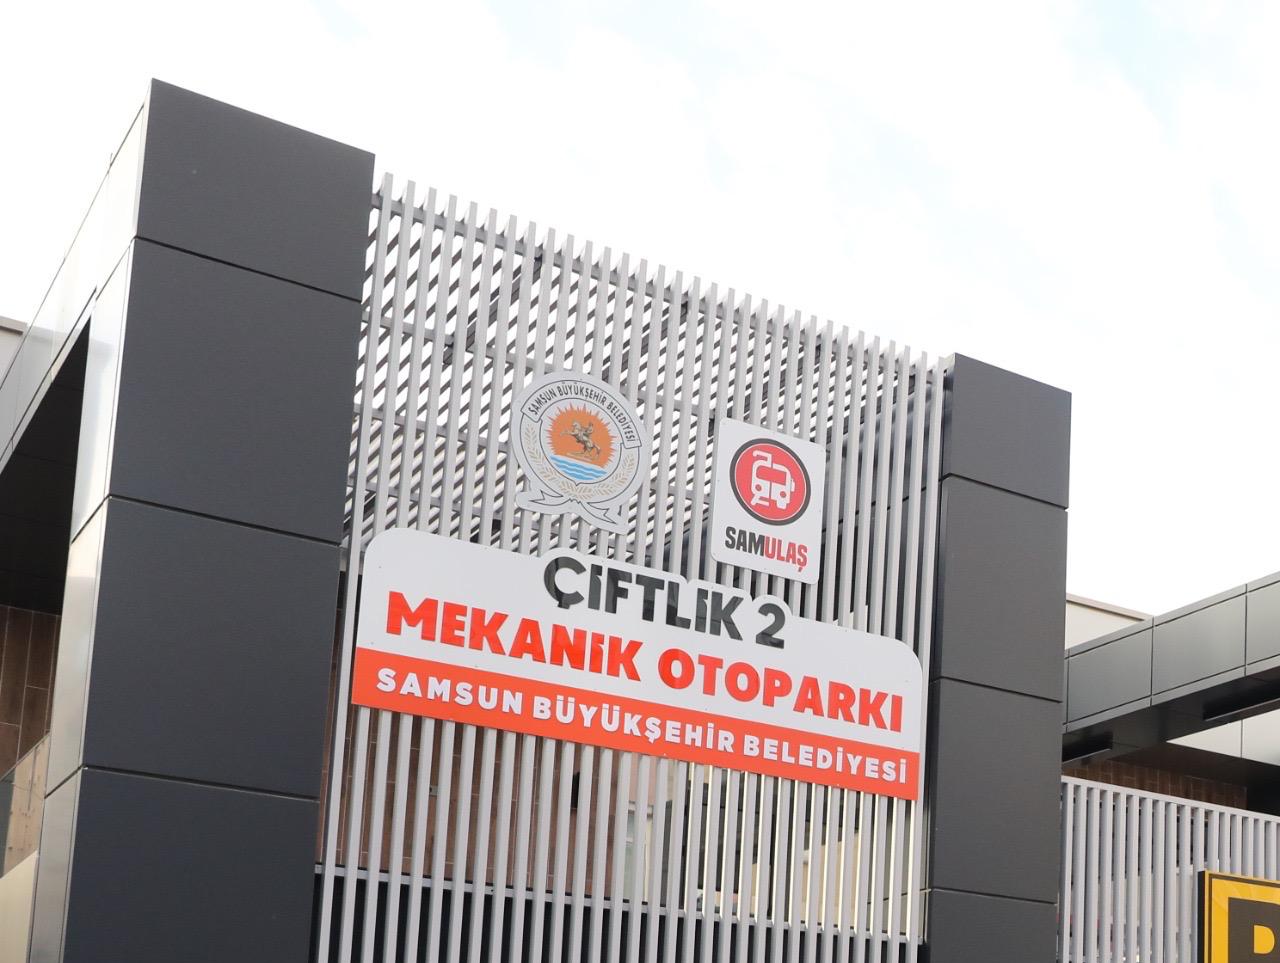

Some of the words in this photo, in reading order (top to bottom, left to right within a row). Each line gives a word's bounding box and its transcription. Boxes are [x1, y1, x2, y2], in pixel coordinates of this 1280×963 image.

[528, 389, 556, 415] SAMSUN
[557, 382, 607, 405] BÜYÜKŞEHİR
[606, 404, 635, 442] BELEDİYESİ
[725, 526, 808, 572] SAMULAŞ
[543, 556, 743, 640] ÇİFTLİK
[755, 603, 786, 649] 2
[386, 591, 641, 681] MEKANİK
[657, 648, 903, 731] OTOPARKI
[377, 668, 522, 715] SAMSUN
[532, 695, 735, 754] BÜYÜKŞEHİR
[743, 736, 907, 785] BELEDİYESİ
